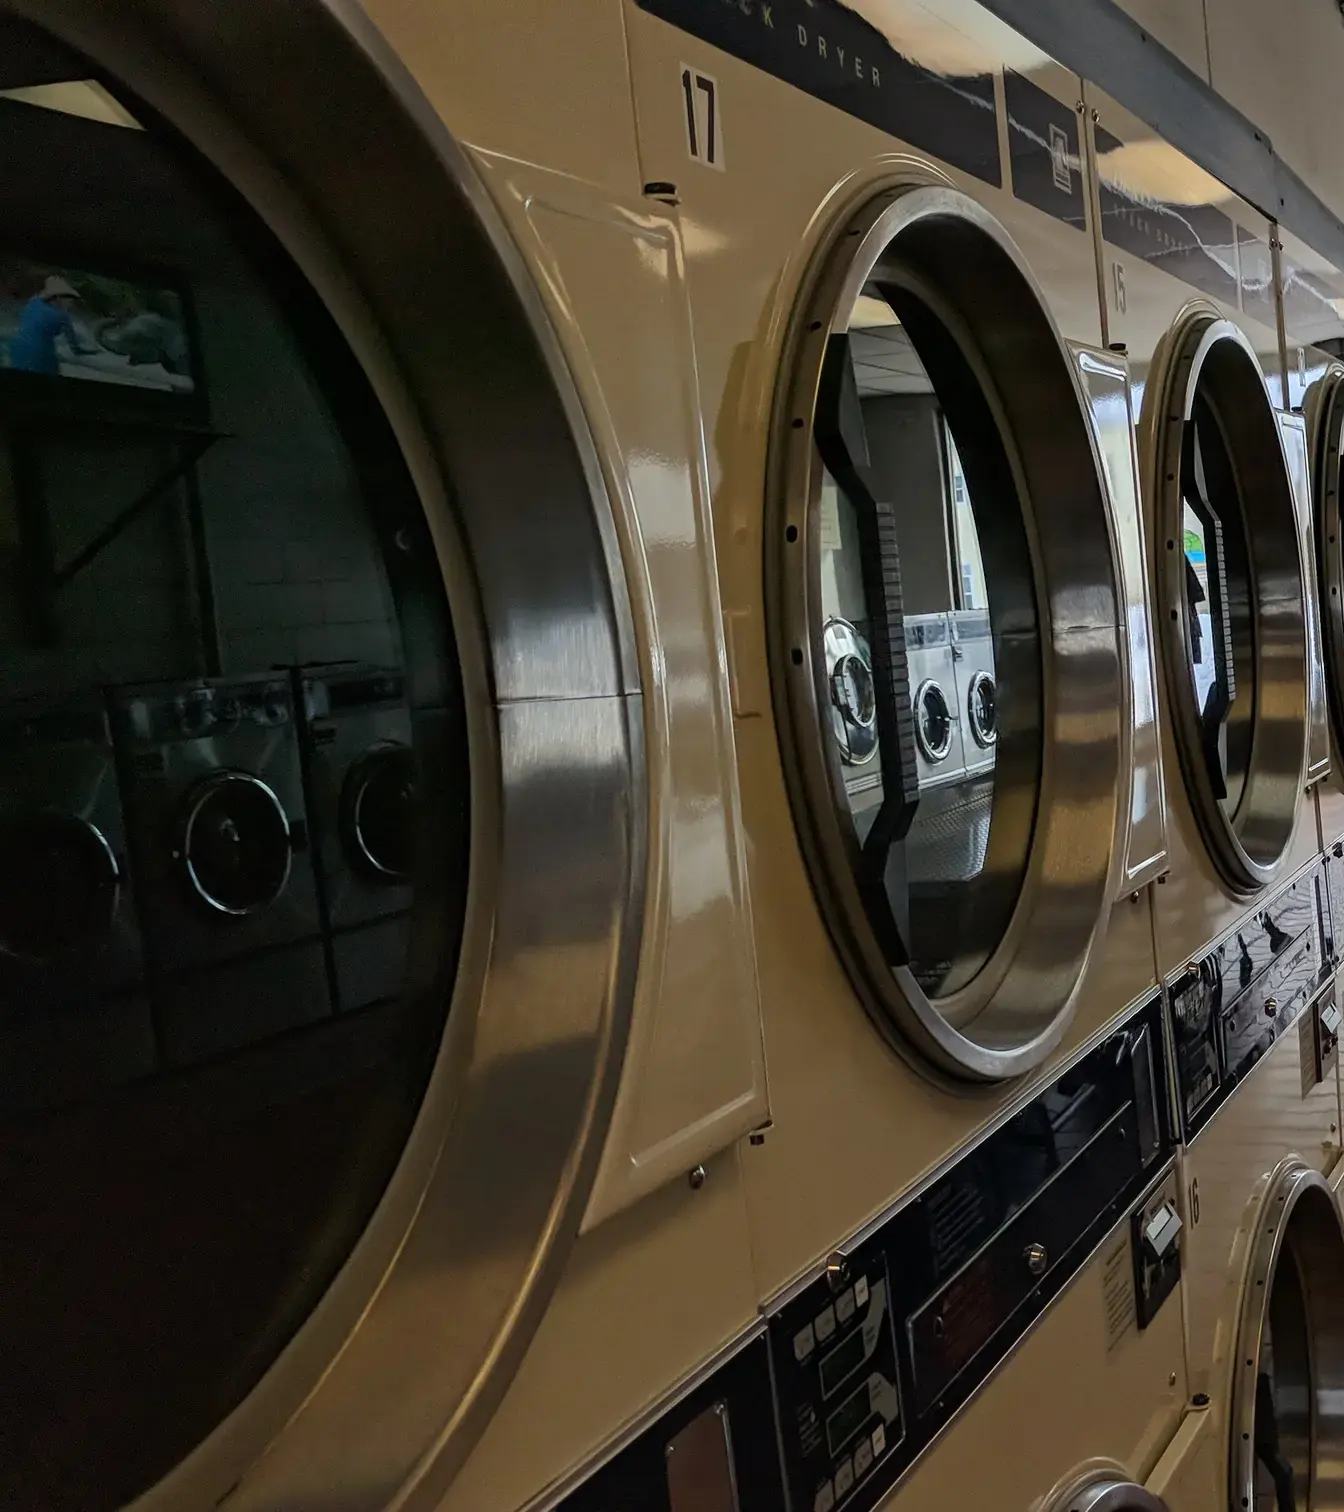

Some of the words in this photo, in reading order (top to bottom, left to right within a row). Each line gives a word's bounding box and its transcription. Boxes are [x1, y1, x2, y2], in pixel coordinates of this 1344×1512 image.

[797, 24, 881, 88] DRYER
[682, 69, 715, 163] 17
[1188, 1176, 1200, 1230] 16
